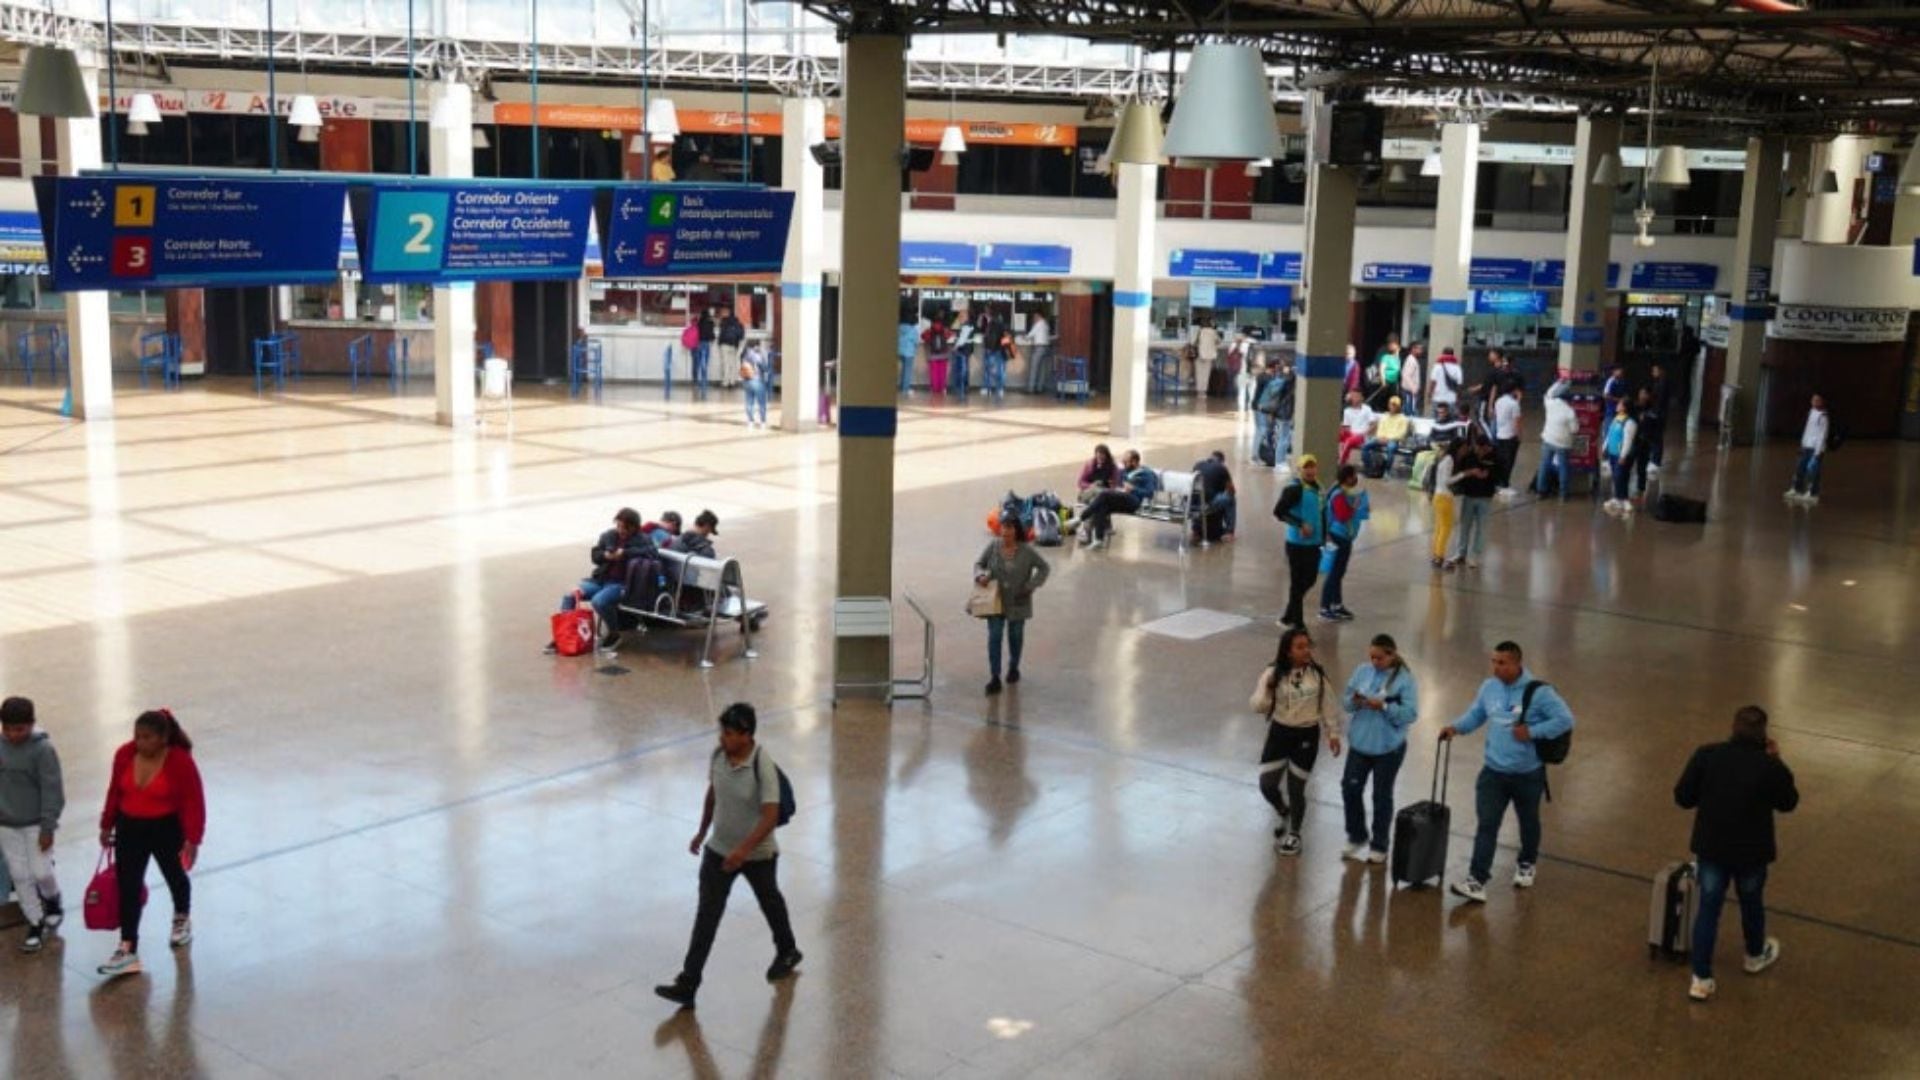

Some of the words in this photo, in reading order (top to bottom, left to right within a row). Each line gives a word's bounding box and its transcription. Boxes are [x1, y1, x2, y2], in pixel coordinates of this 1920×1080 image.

[167, 187, 220, 200] Corredor
[222, 189, 243, 200] Sur
[456, 191, 512, 204] Corredor
[515, 192, 560, 204] Oriente
[130, 196, 142, 217] 1
[659, 201, 672, 218] 4
[453, 216, 509, 230] Corredor
[511, 217, 571, 230] Occidente
[404, 213, 434, 252] 2
[713, 229, 725, 239] de
[164, 239, 217, 250] Corredor
[218, 239, 251, 250] Norte
[652, 241, 665, 258] 5
[127, 246, 146, 268] 3
